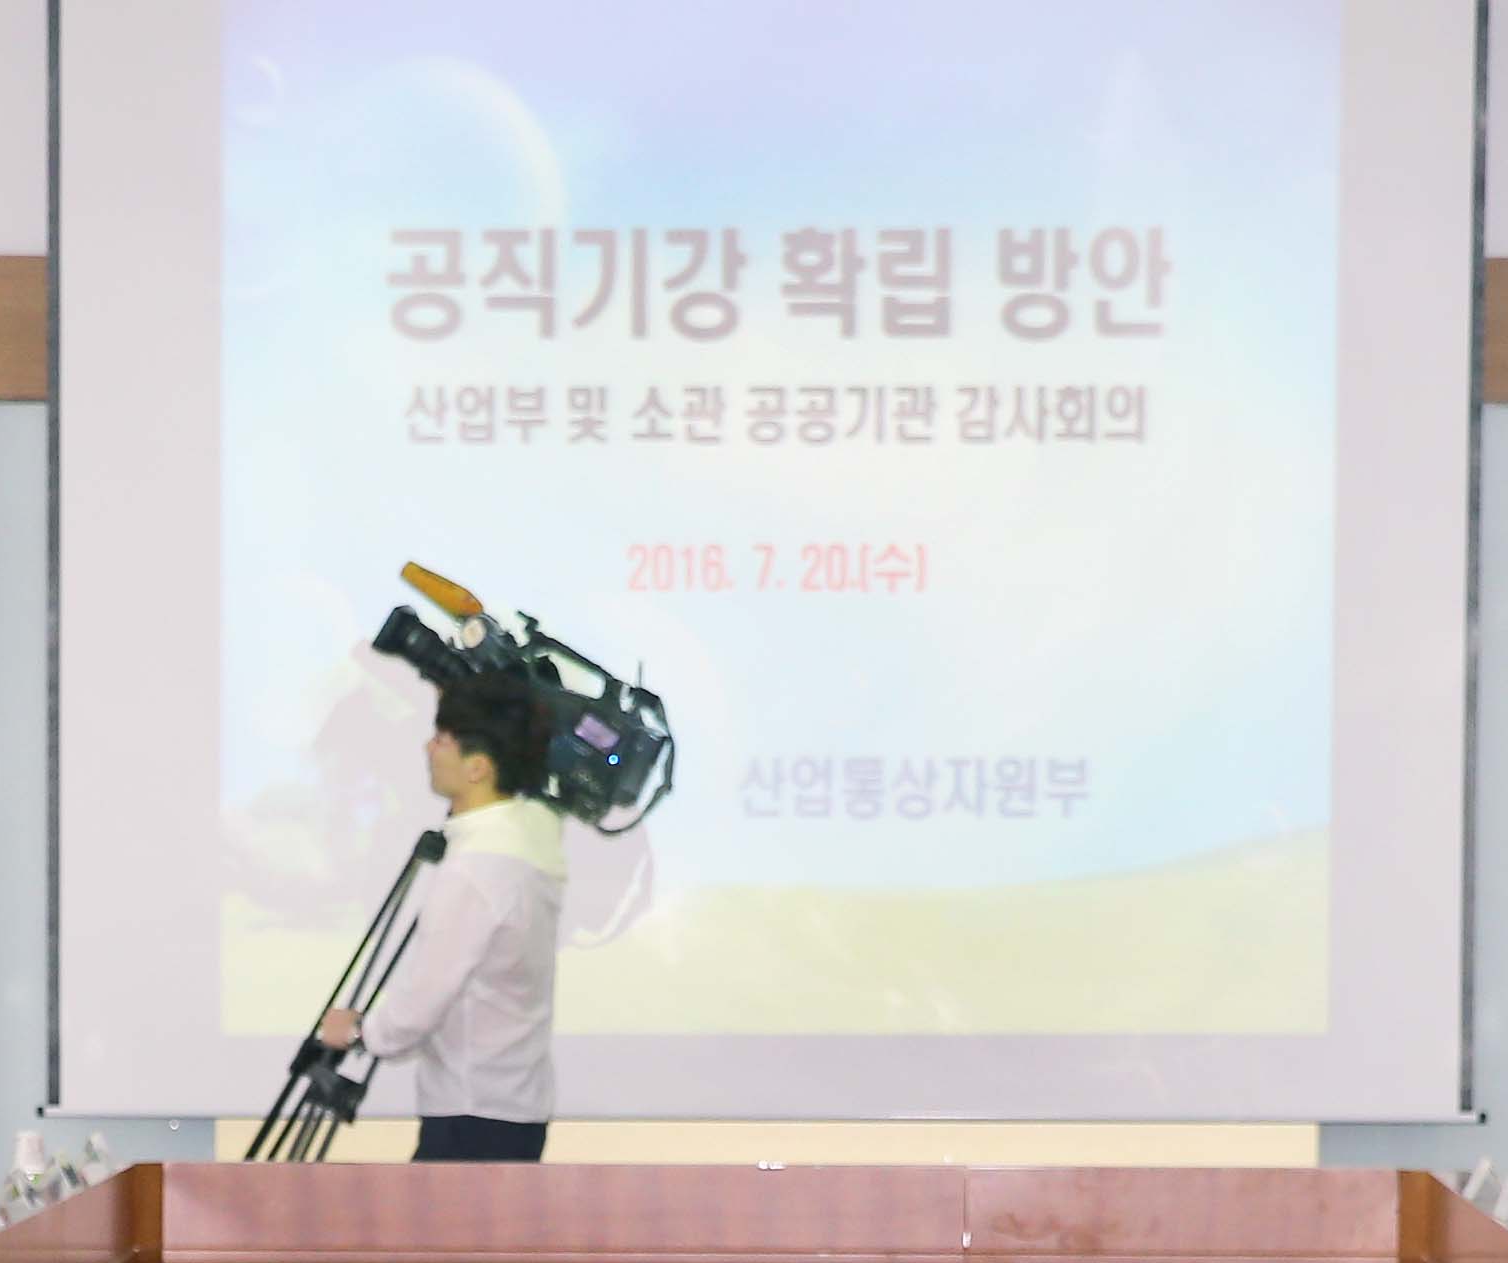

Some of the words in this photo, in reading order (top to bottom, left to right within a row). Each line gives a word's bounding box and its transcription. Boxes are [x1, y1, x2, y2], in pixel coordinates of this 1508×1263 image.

[385, 226, 749, 342] 공직기강
[779, 226, 955, 340] 확립
[996, 226, 1173, 342] 방안
[403, 383, 551, 446] 산업부
[565, 384, 610, 446] 및
[629, 383, 728, 446] 소관
[745, 384, 938, 445] 공공기관
[955, 383, 1148, 445] 감사회의
[626, 543, 735, 593] 2016.
[750, 543, 787, 593] 7.
[739, 757, 1091, 822] 산업통상자원부
